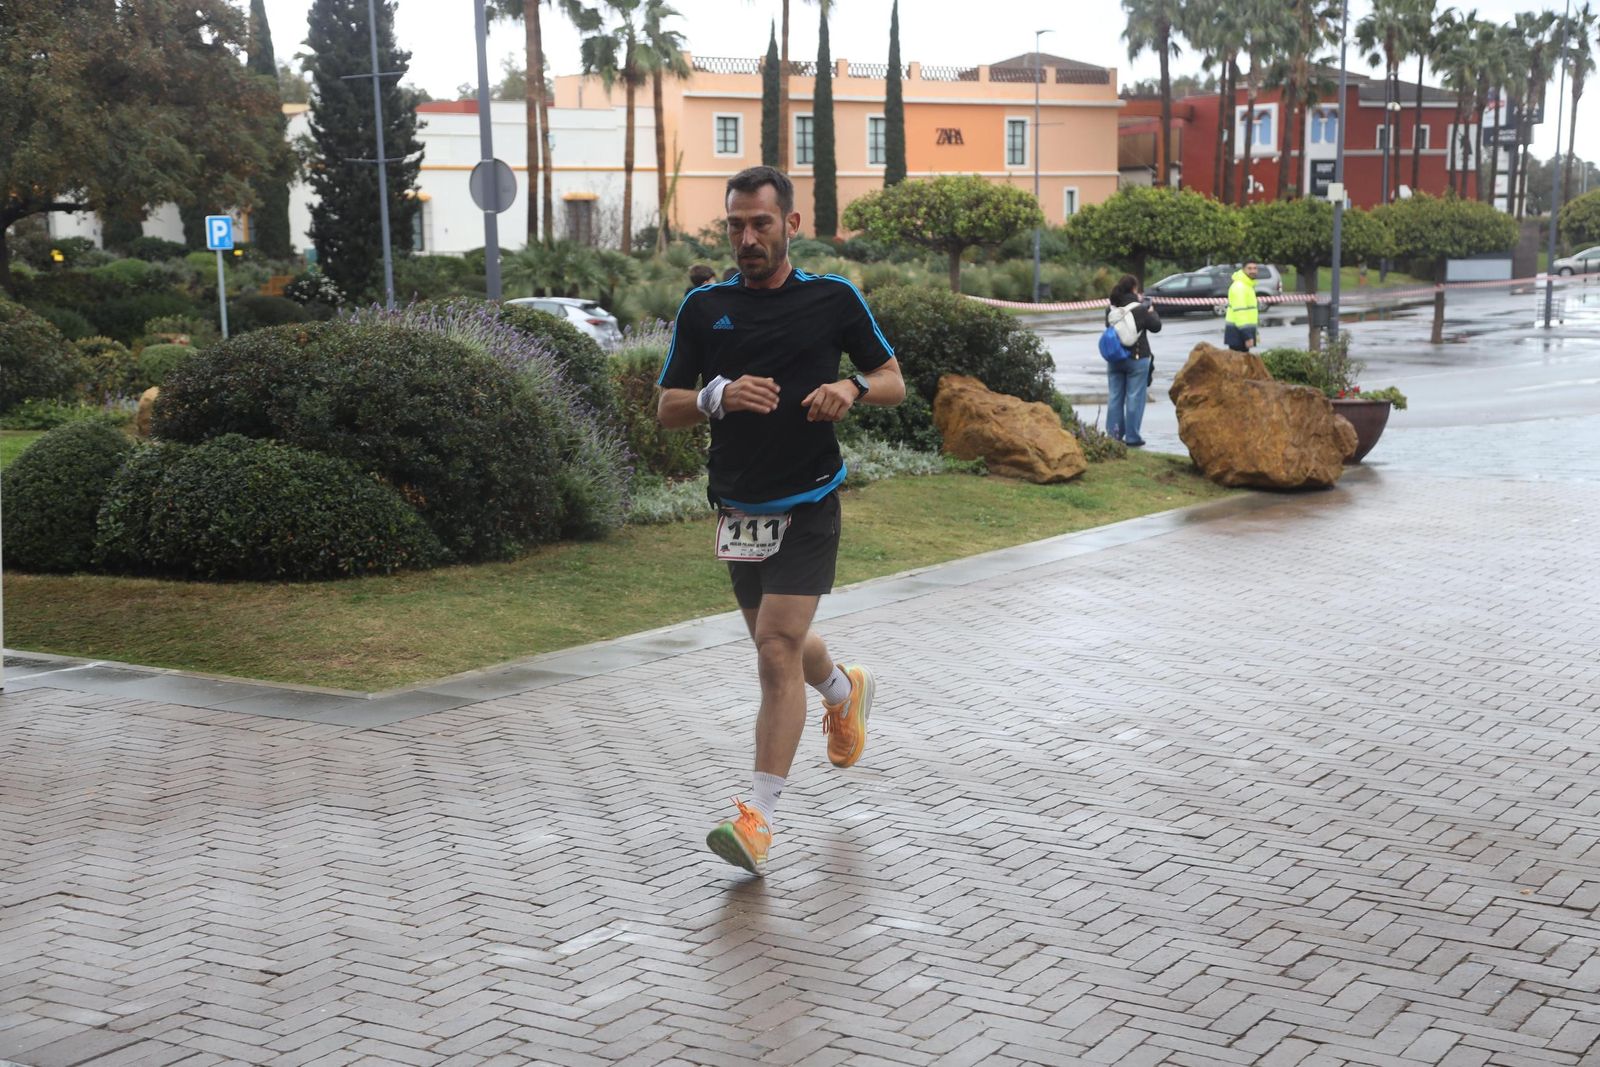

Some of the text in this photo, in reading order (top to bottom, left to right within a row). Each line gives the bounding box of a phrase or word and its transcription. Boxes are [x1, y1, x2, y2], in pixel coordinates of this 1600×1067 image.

[935, 128, 964, 145] ZARA
[212, 219, 228, 246] P
[727, 519, 780, 542] 111
